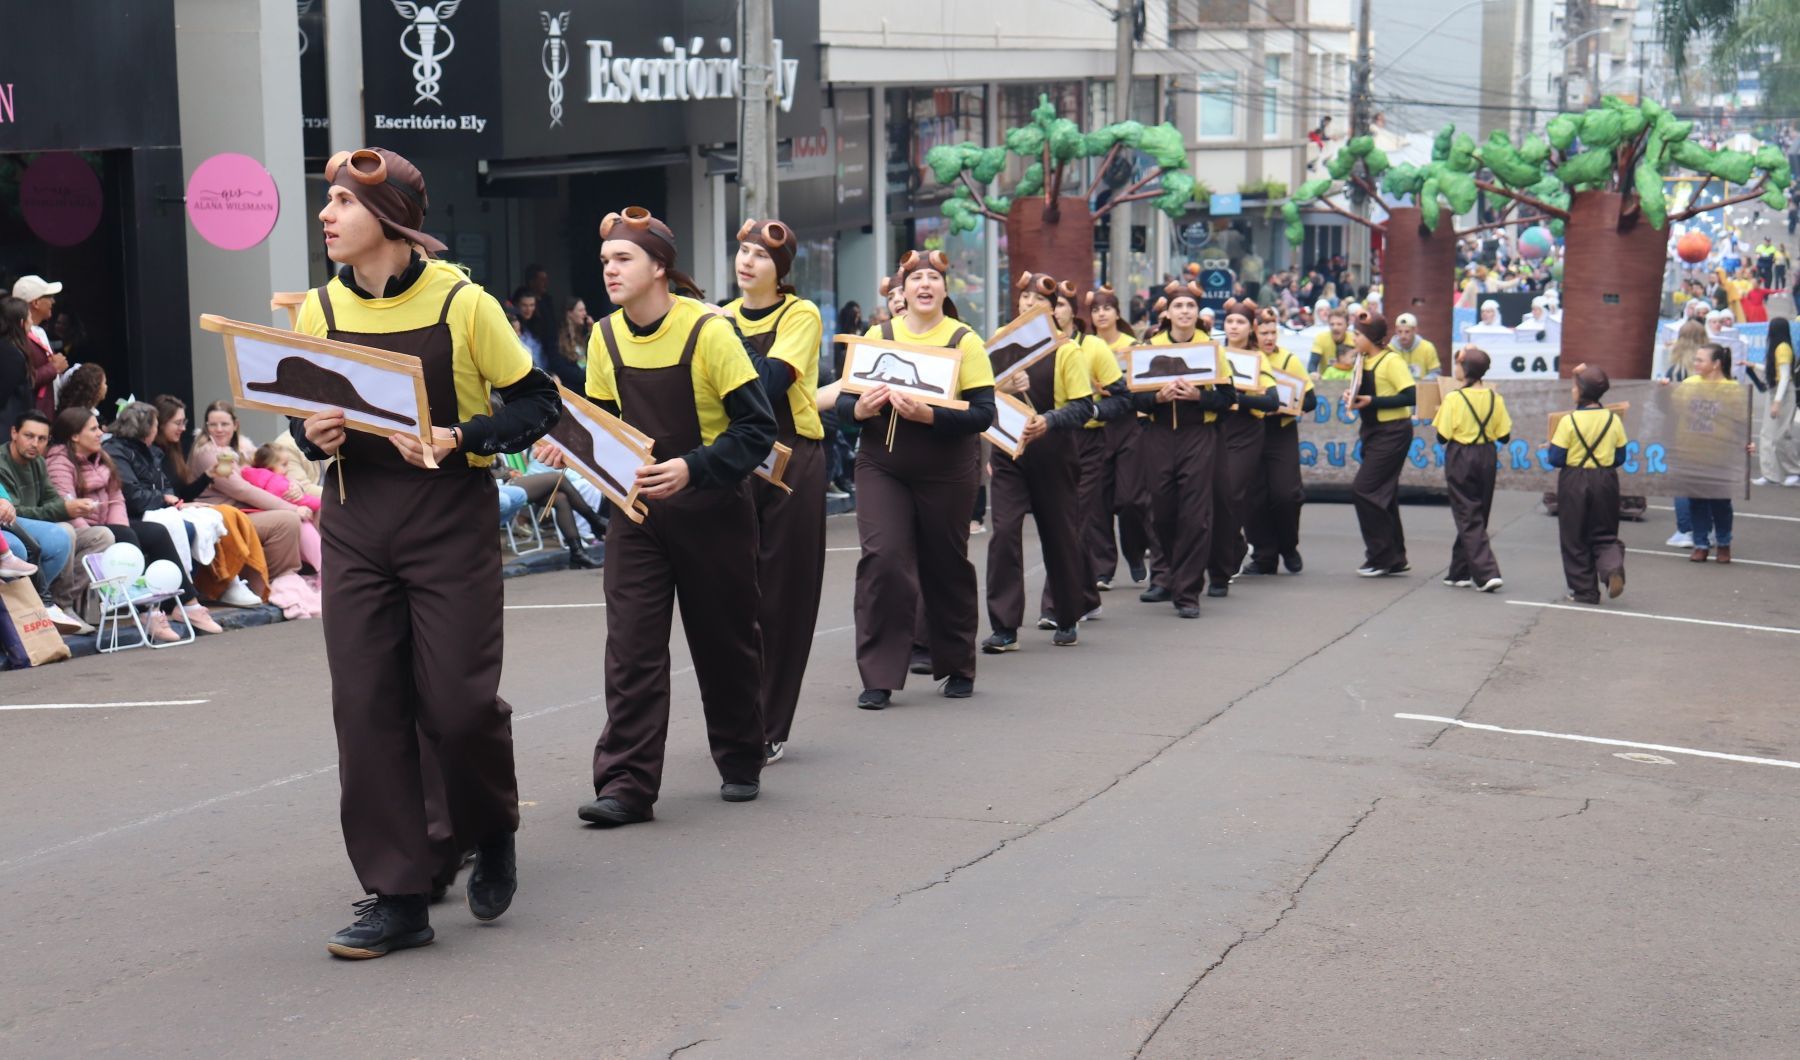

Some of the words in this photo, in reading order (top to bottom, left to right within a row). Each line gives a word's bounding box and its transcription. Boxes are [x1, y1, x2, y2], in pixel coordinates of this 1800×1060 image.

[772, 39, 799, 112] ly
[374, 114, 457, 130] Escritório
[460, 115, 487, 133] Ely
[194, 201, 223, 210] ALANA
